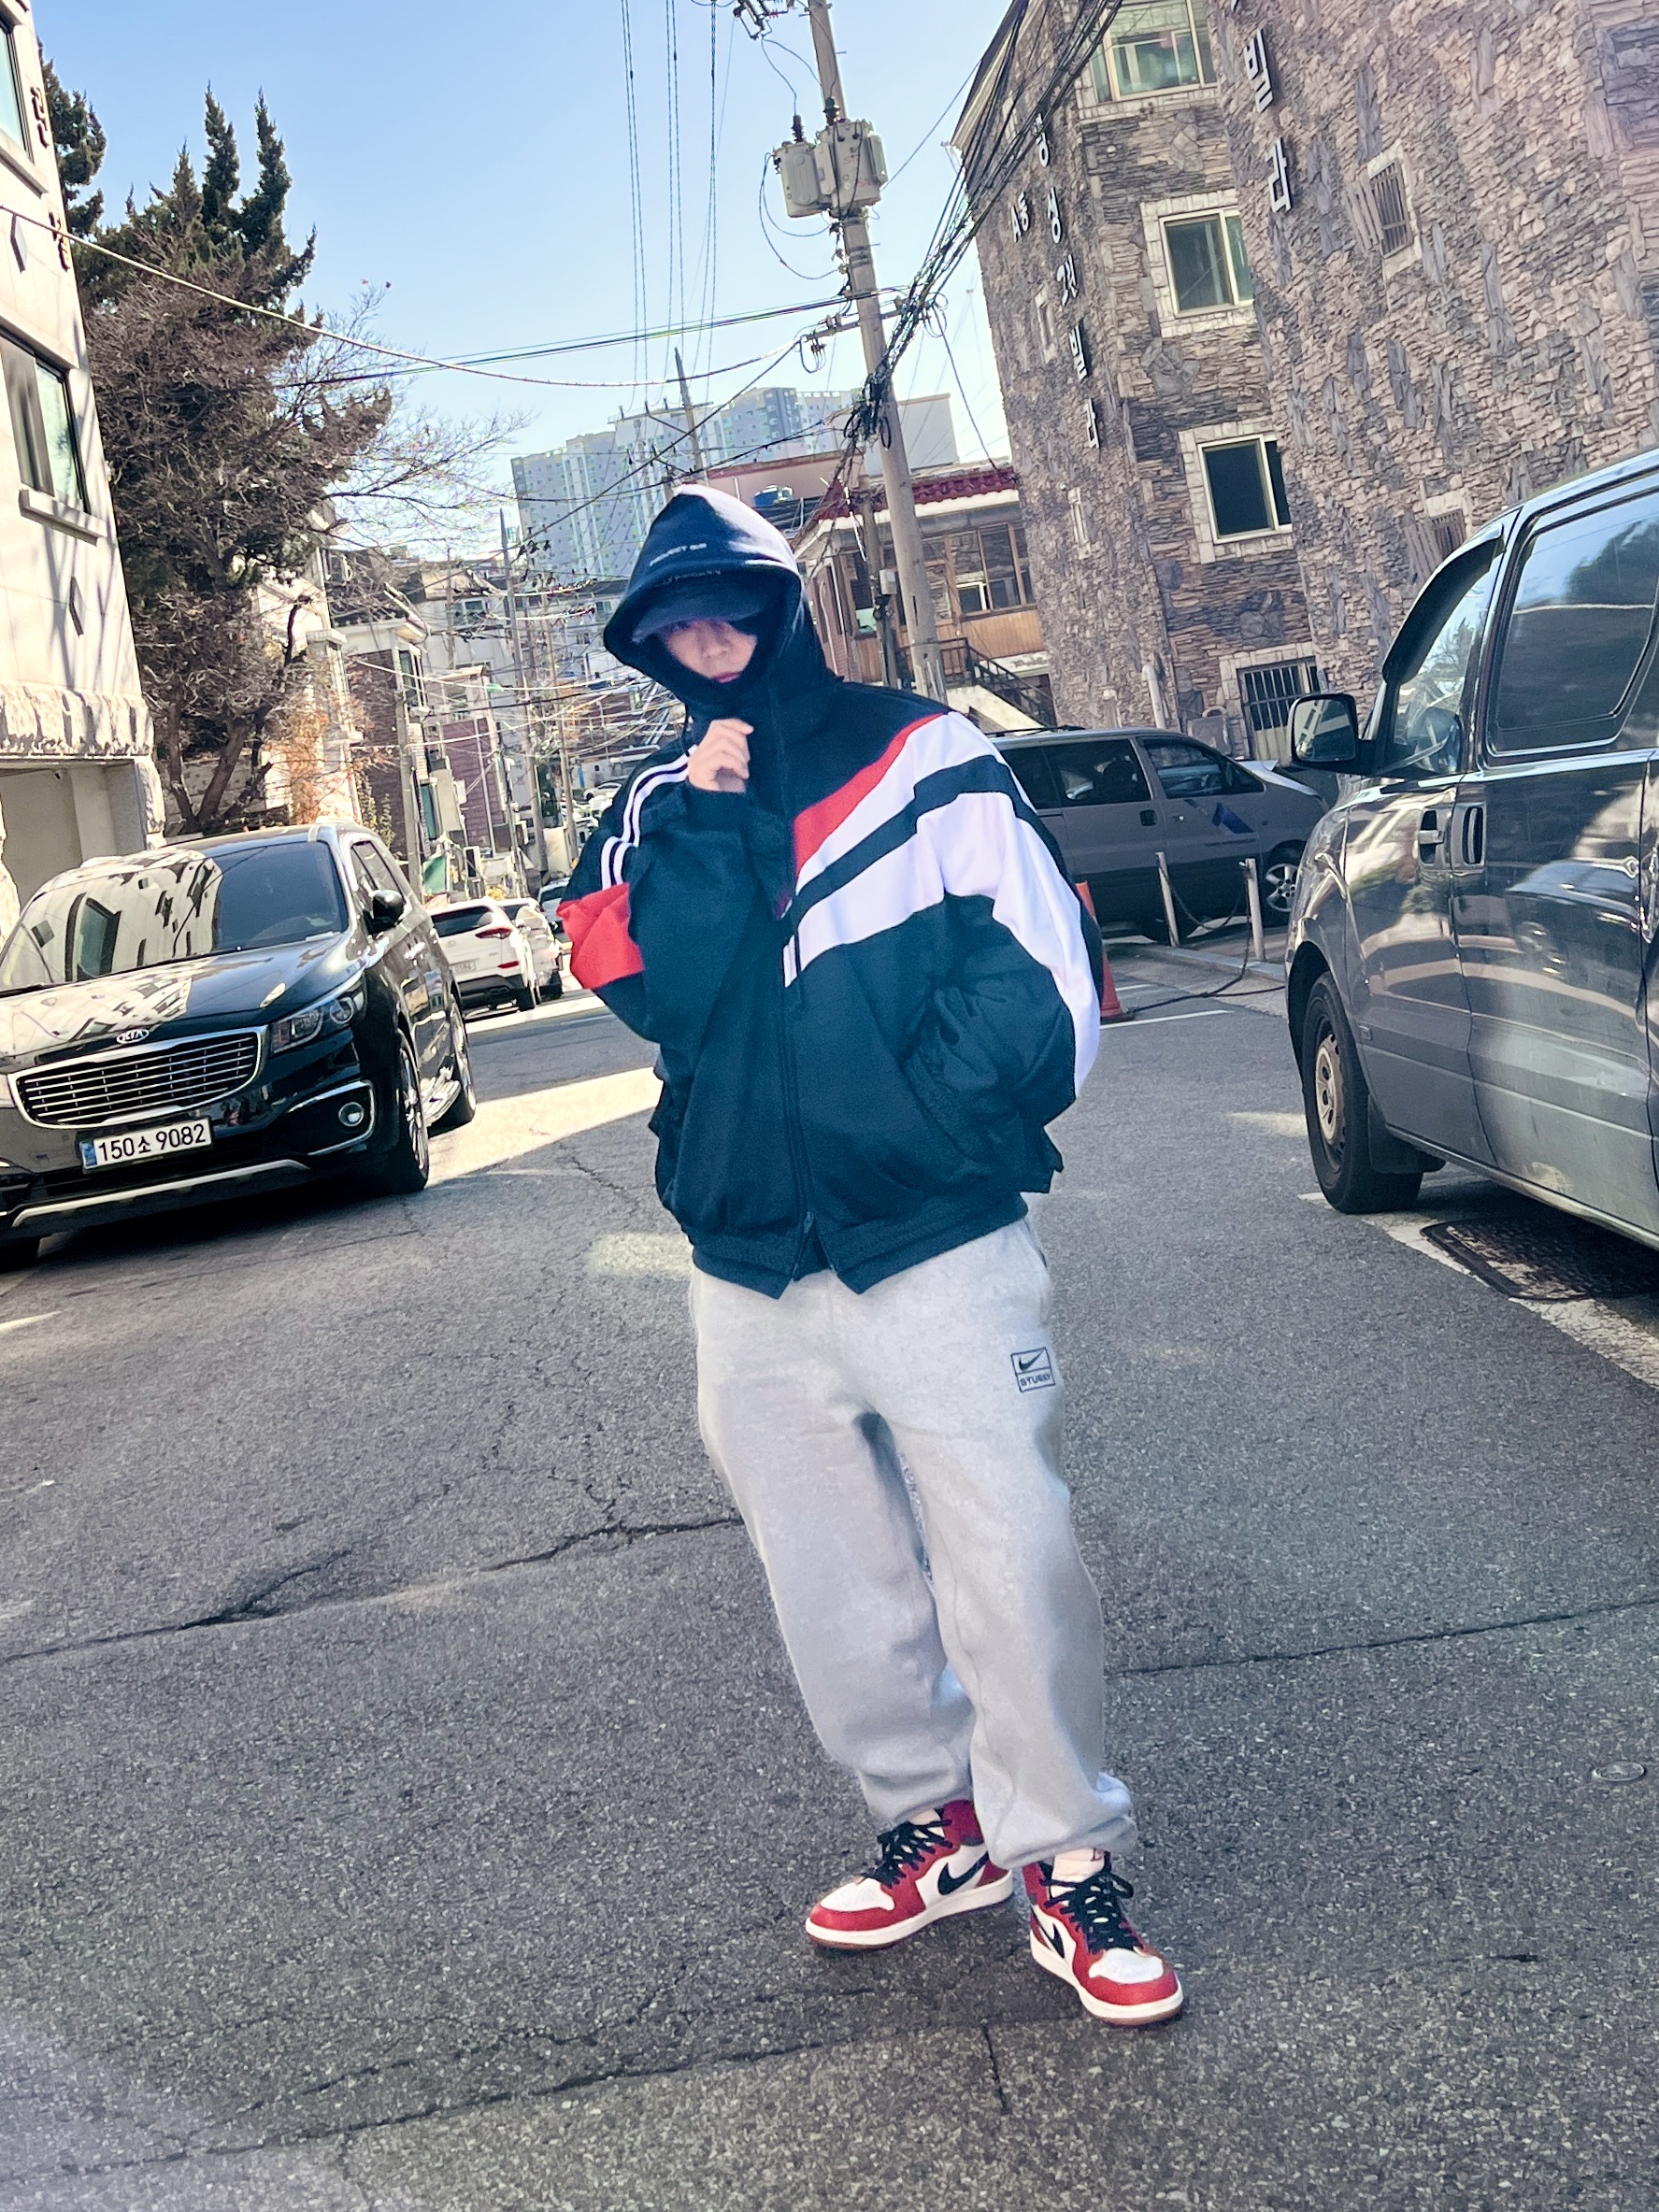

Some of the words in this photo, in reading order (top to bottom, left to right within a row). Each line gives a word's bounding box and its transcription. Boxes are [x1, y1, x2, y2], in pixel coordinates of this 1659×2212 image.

[1231, 0, 1292, 213] 빌라
[1010, 191, 1029, 243] A동
[98, 1135, 151, 1162] 150소
[155, 1123, 206, 1149] 9082
